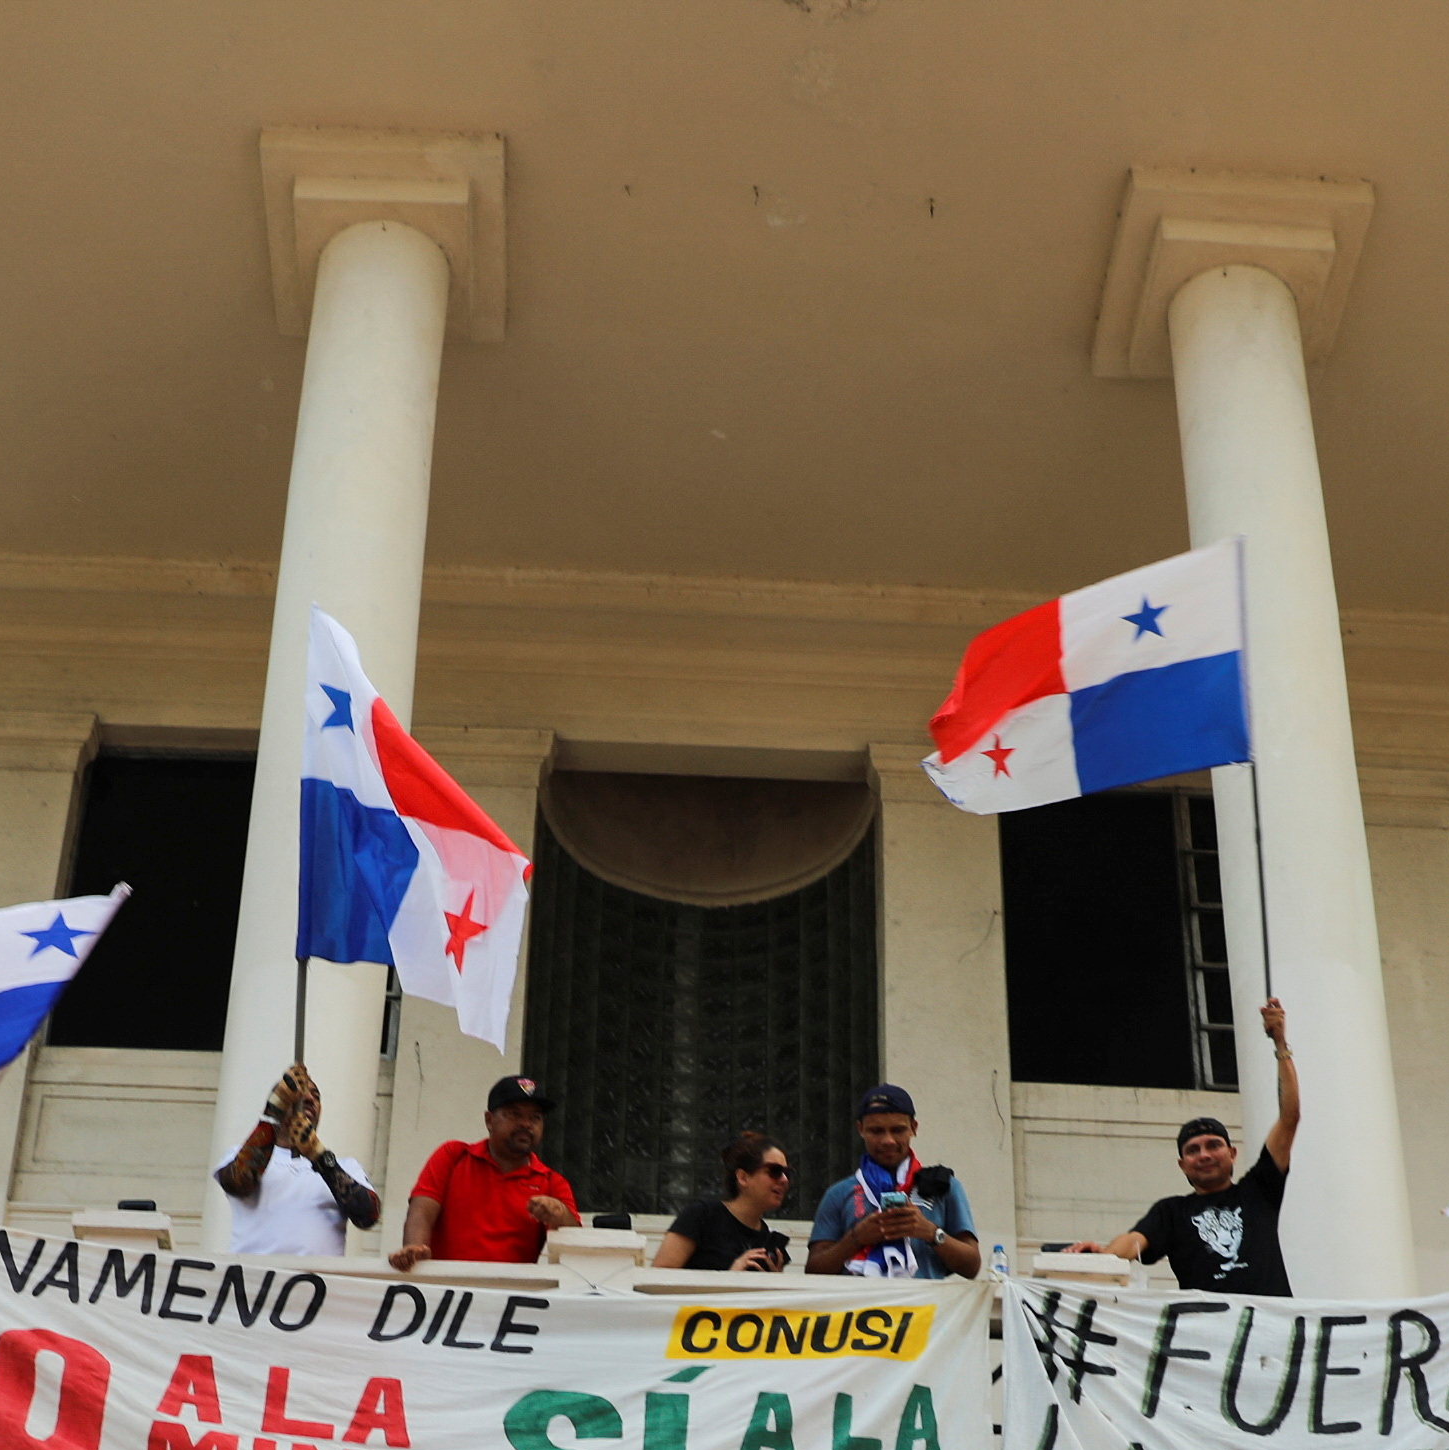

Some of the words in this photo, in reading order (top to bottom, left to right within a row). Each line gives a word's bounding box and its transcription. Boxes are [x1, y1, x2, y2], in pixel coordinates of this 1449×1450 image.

[368, 1285, 550, 1354] DILE
[680, 1309, 914, 1355] CONUSI
[156, 1354, 222, 1424] A
[261, 1366, 410, 1448] LA
